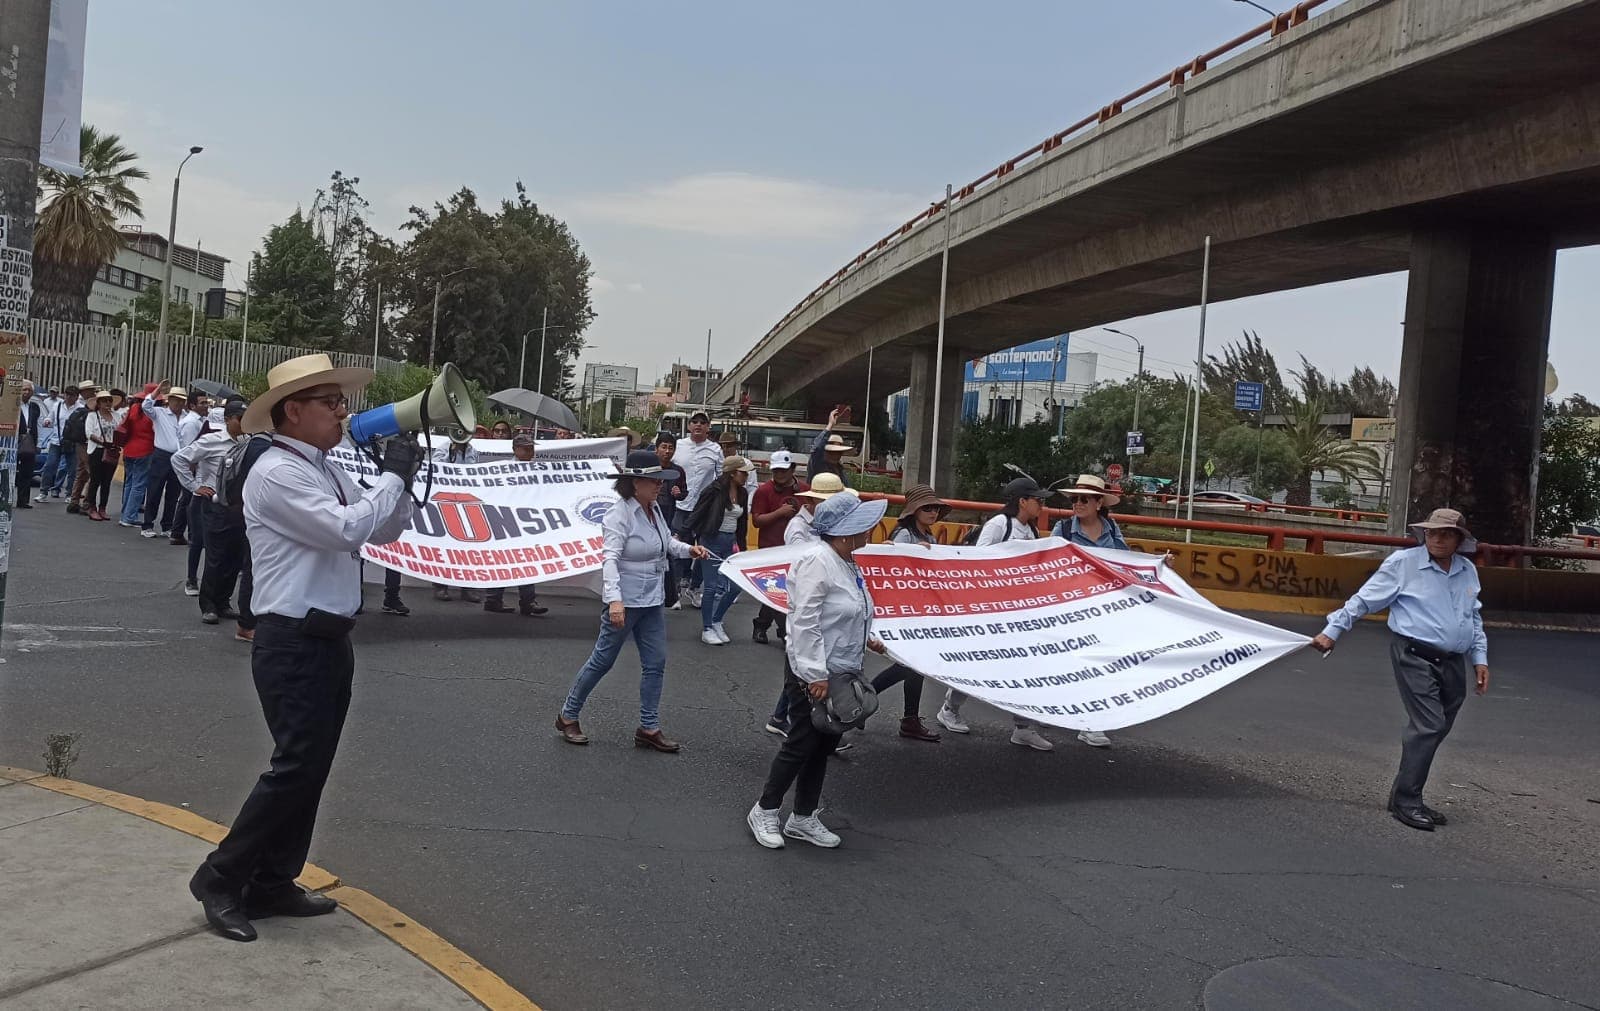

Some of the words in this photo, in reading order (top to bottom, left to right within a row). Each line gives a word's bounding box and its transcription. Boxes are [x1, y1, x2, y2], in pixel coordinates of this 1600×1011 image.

[443, 466, 462, 476] DE
[466, 461, 549, 476] DOCENTES
[551, 461, 571, 471] DE
[573, 461, 592, 471] LA
[484, 478, 504, 487] DE
[507, 475, 539, 486] SAN
[365, 545, 404, 567] UNA
[405, 560, 539, 581] UNIVERSIDAD
[541, 560, 568, 575] DE
[418, 545, 445, 563] DE
[446, 543, 560, 566] INGENIERÍA
[560, 540, 587, 556] DE
[1256, 553, 1297, 576] DINA
[872, 580, 893, 589] LA
[896, 579, 976, 590] DOCENCIA
[979, 563, 1096, 588] UNIVERSITARIA
[915, 567, 992, 578] NACIONAL
[994, 555, 1083, 576] INDEFINIDA
[874, 606, 897, 616] DE
[900, 605, 921, 615] EL
[924, 604, 942, 614] 26
[944, 603, 967, 614] DE
[969, 594, 1060, 612] SETIEMBRE
[1063, 589, 1085, 600] DE
[1088, 579, 1124, 594] 2023
[1247, 573, 1341, 598] ASESINA
[880, 630, 899, 641] EL
[899, 624, 985, 640] INCREMENTO
[987, 623, 1006, 634] DE
[1006, 607, 1102, 633] PRESUPUESTO
[1102, 597, 1141, 614] PARA
[1140, 590, 1159, 604] LA
[939, 647, 1028, 662] UNIVERSIDAD
[1028, 634, 1101, 657] PÚBLICA!!!
[983, 680, 1005, 689] DE
[1005, 679, 1023, 689] LA
[1023, 666, 1104, 689] AUTONOMÍA
[1043, 706, 1064, 715] DE
[1064, 704, 1083, 715] LA
[1082, 698, 1111, 714] LEY
[1110, 692, 1135, 707] DE
[1133, 643, 1262, 700] HOMOLOGACIÓN!!!
